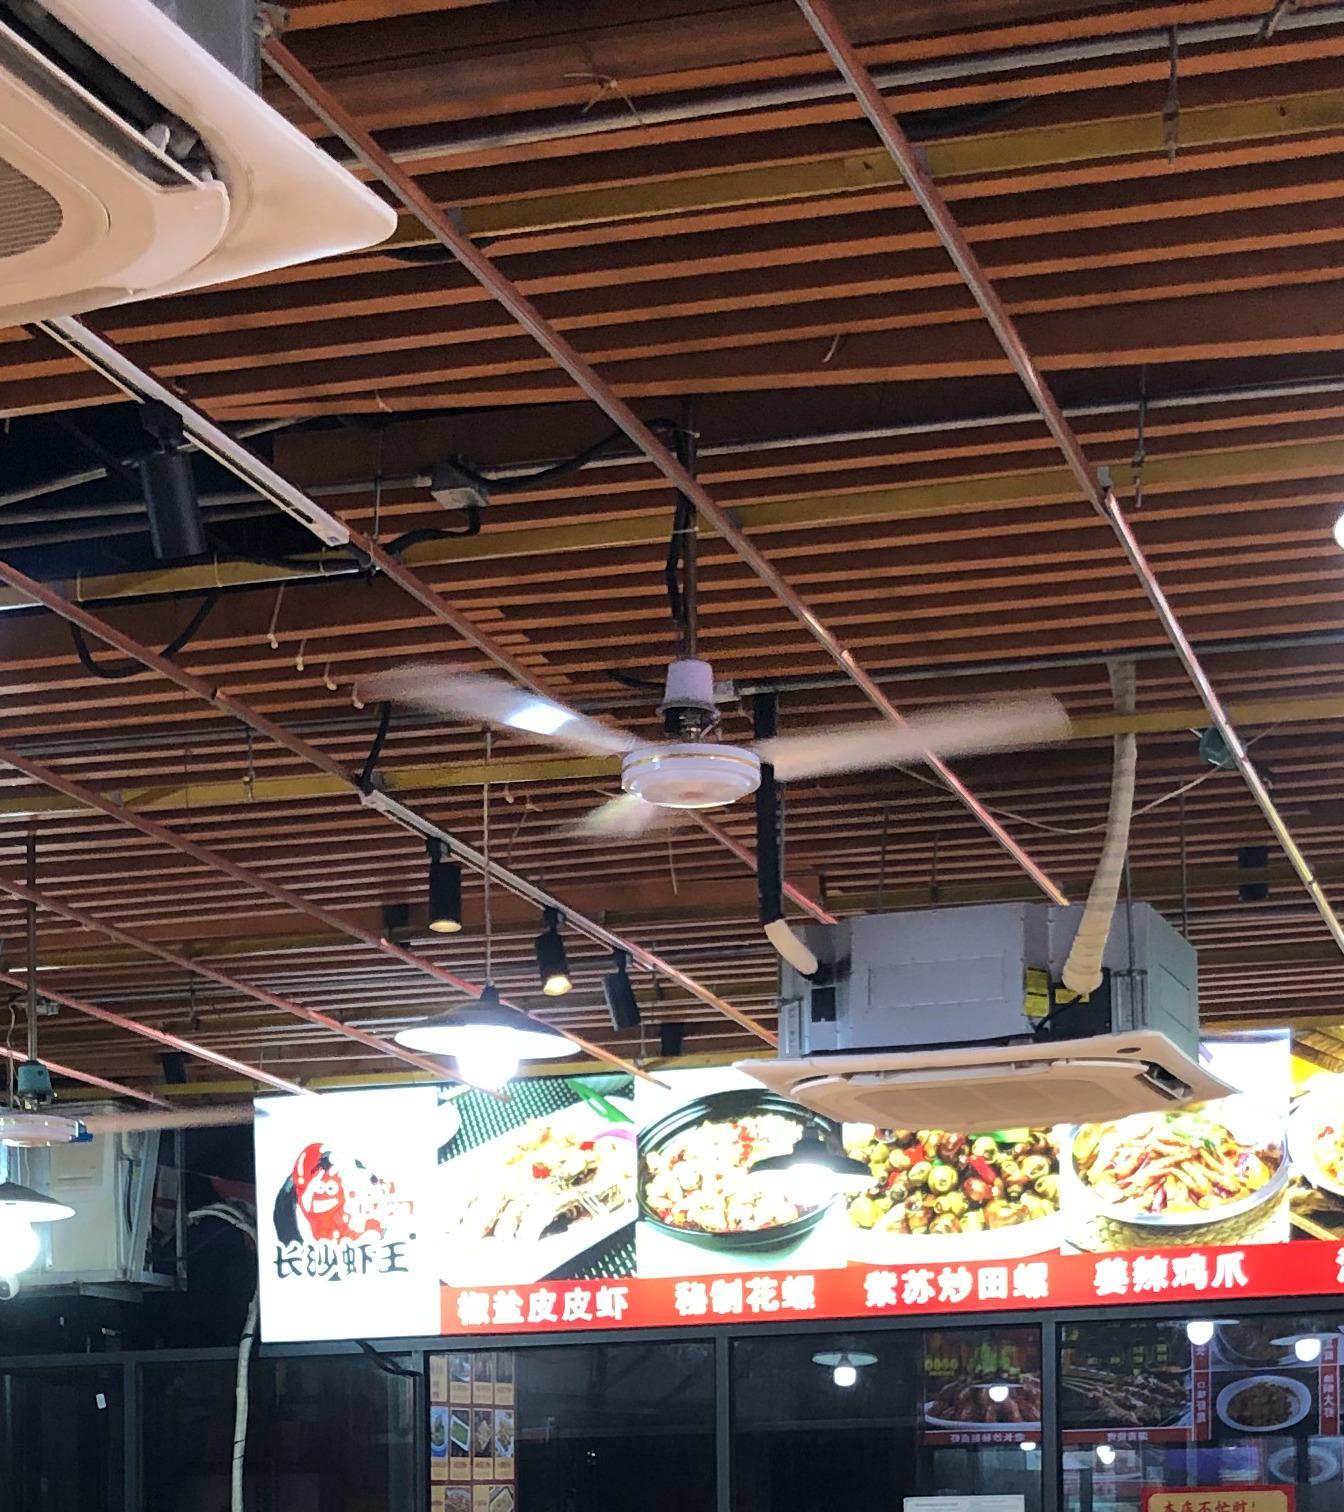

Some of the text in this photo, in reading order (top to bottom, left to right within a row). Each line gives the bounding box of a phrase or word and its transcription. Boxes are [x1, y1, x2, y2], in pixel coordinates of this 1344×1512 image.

[274, 1241, 410, 1282] 长沙虾王
[1093, 1252, 1249, 1297] 姜辣鸡爪
[457, 1285, 630, 1327] 椒盐皮皮虾
[674, 1274, 816, 1317] 秘制花螺
[863, 1262, 1049, 1307] 紫苏炒田螺
